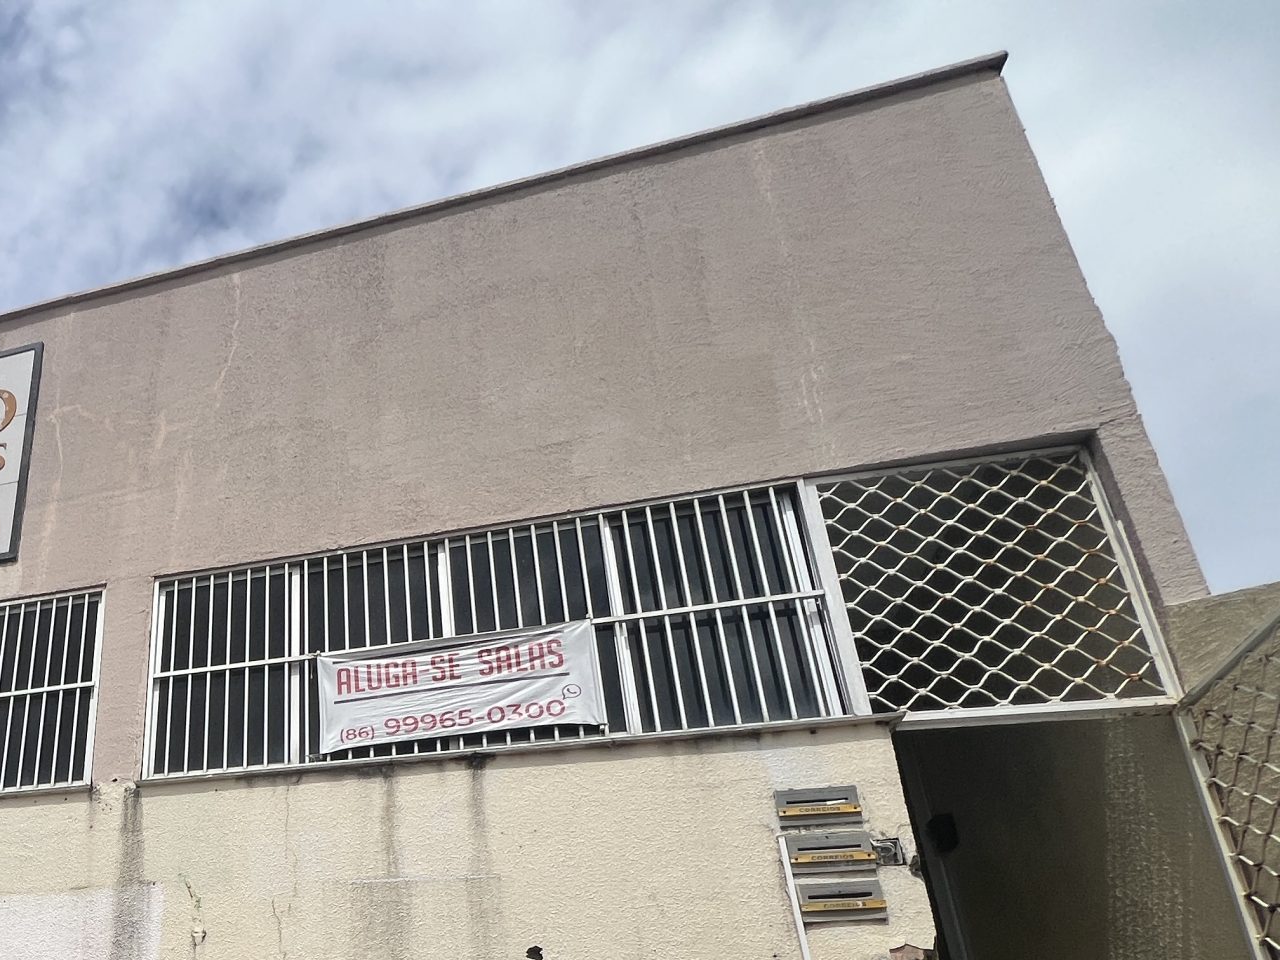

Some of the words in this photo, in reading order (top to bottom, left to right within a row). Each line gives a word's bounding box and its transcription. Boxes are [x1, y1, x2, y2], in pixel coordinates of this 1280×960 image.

[336, 652, 462, 695] ALUGA-SE
[477, 638, 565, 677] SALAS
[339, 726, 376, 744] (86)
[383, 699, 567, 736] 99965-0300
